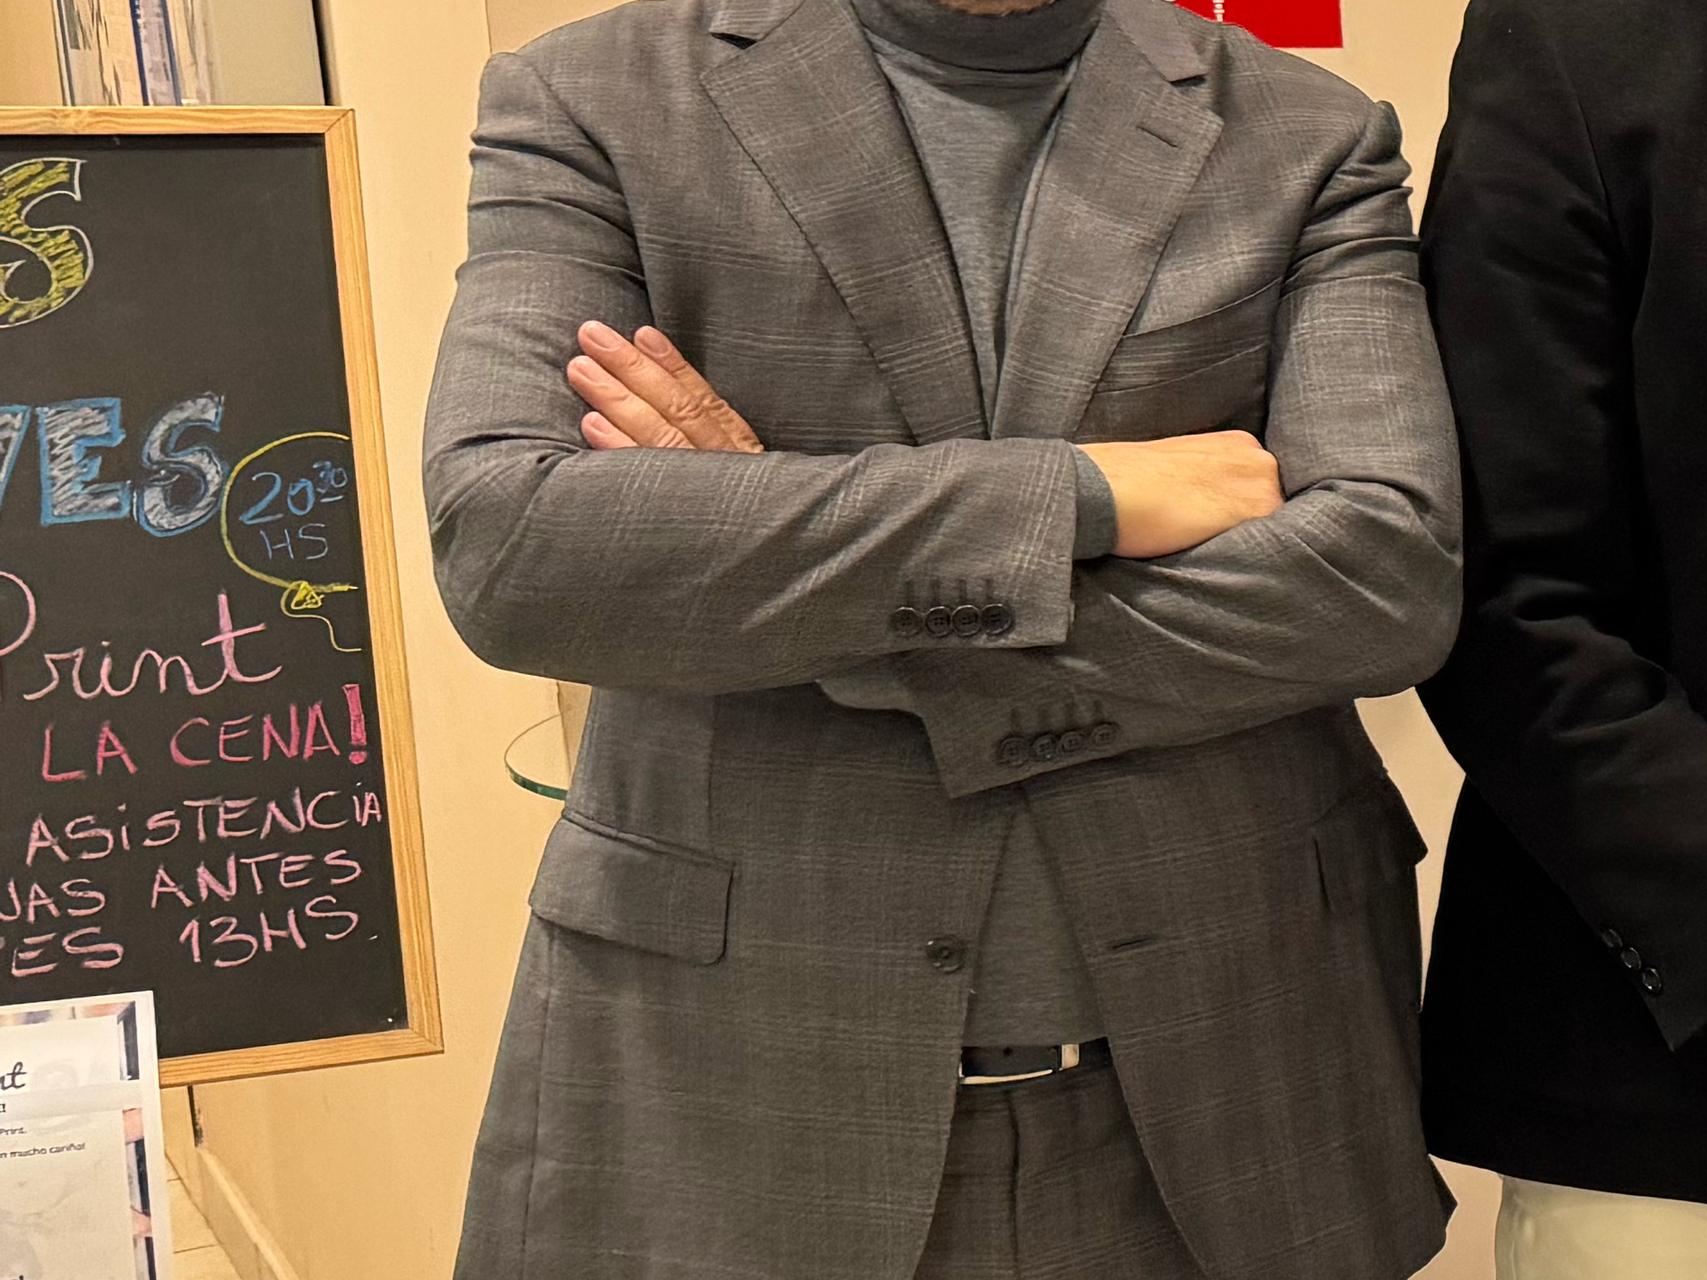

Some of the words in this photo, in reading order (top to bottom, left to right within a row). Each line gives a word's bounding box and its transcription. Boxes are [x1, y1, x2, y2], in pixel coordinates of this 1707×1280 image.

[41, 720, 139, 783] LA
[169, 683, 368, 767] CENA!
[150, 849, 362, 909] ANTES
[0, 926, 125, 978] ES
